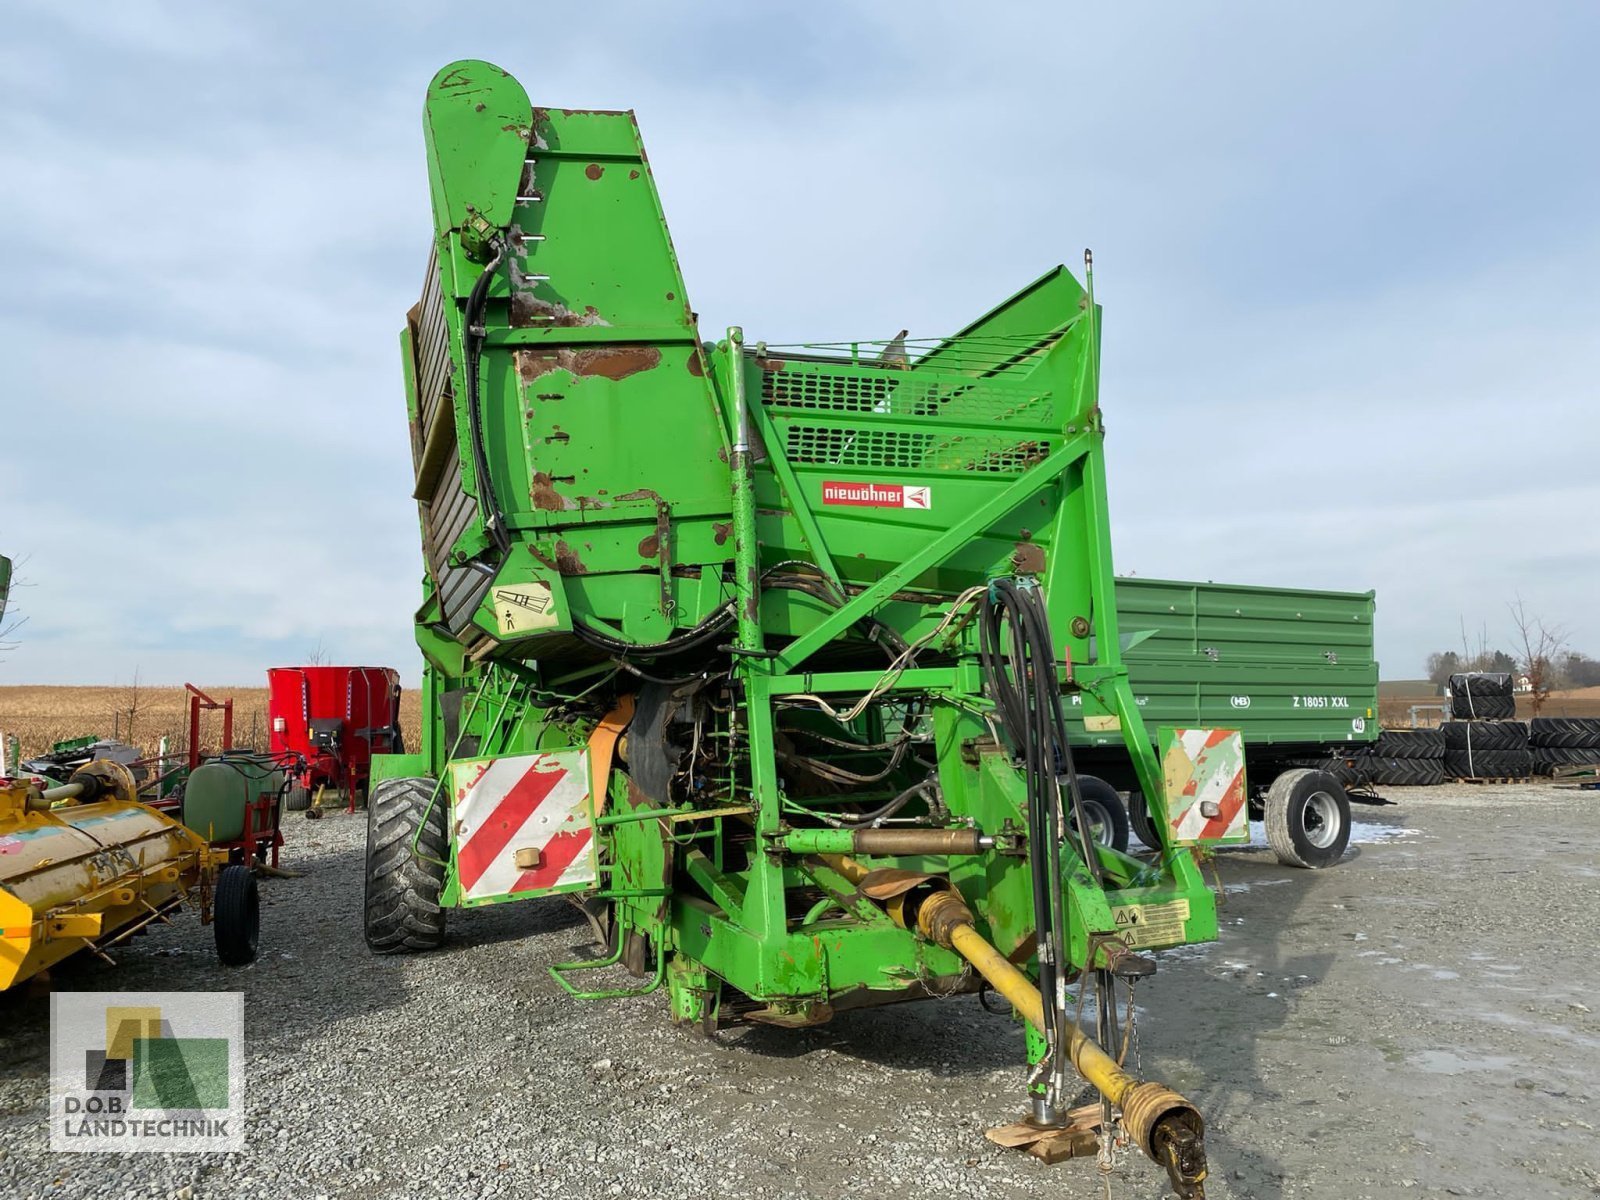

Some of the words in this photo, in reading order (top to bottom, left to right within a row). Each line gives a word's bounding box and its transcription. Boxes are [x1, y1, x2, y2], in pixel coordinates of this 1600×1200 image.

[825, 484, 902, 502] niewöhner
[1293, 696, 1300, 707] Z
[1303, 696, 1328, 707] 18051
[1331, 696, 1349, 707] XXL
